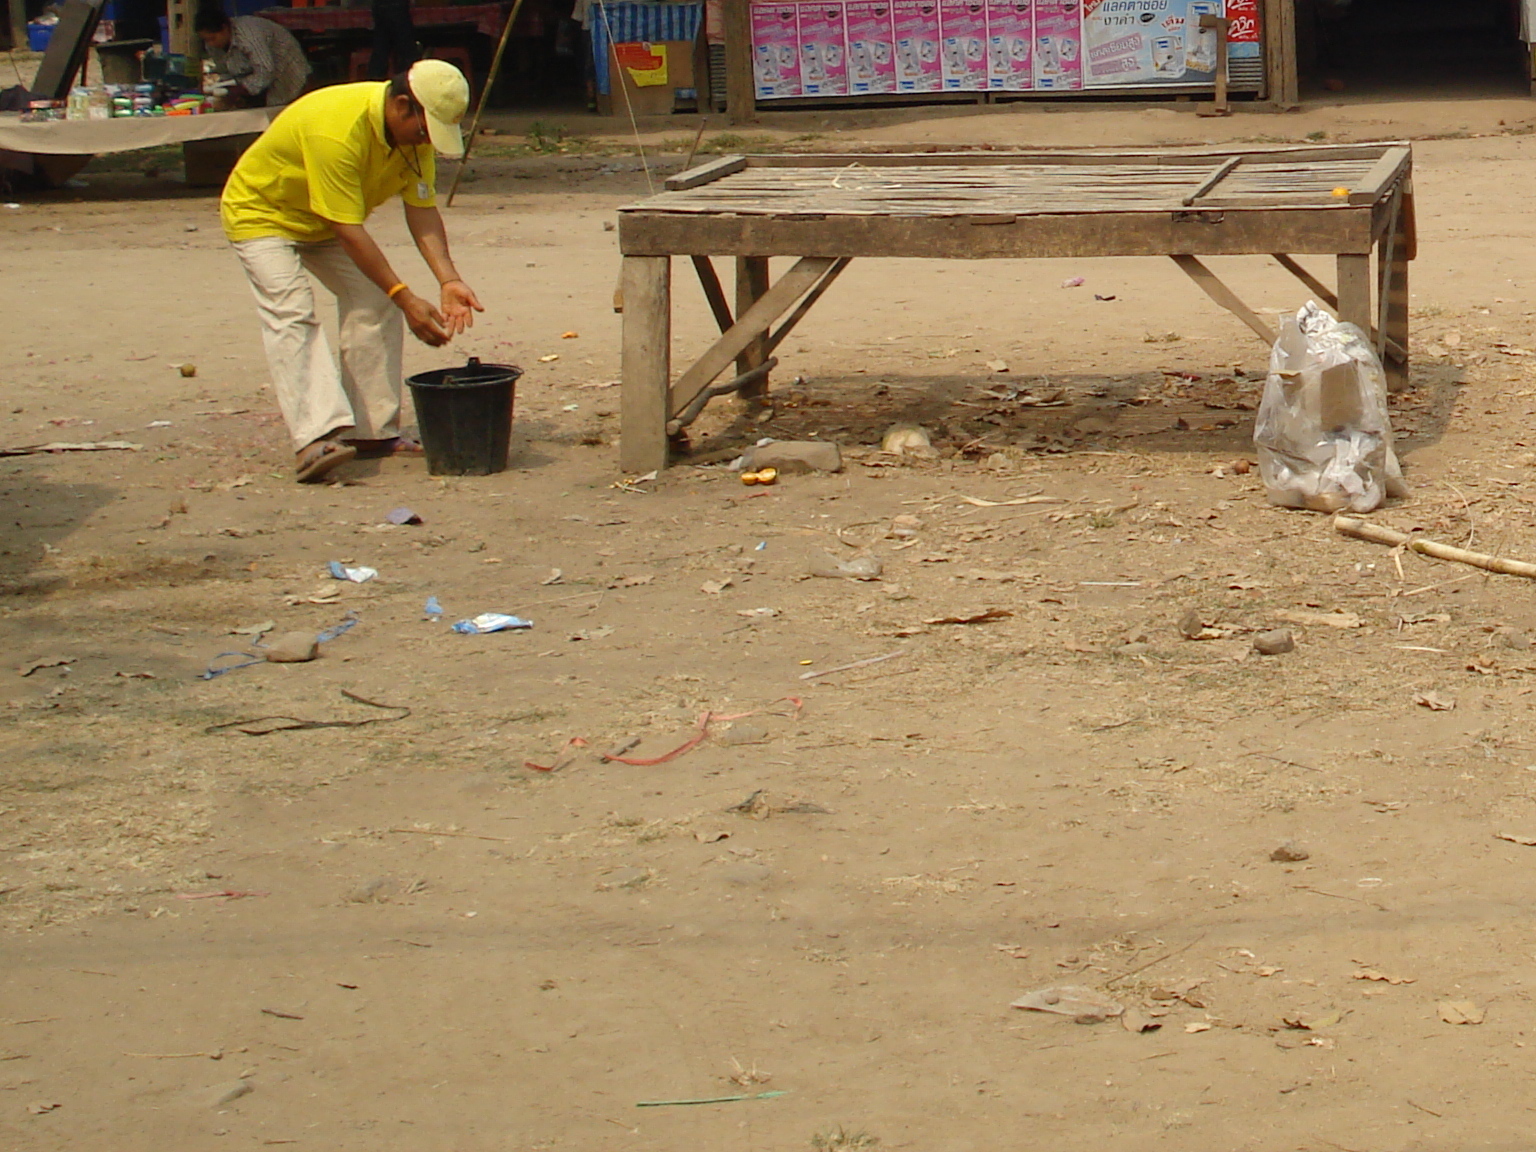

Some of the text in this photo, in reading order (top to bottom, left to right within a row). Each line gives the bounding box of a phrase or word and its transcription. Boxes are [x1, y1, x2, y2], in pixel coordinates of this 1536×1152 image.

[1102, 0, 1168, 12] แลคตาซอย
[1104, 13, 1135, 26] งาดำ
